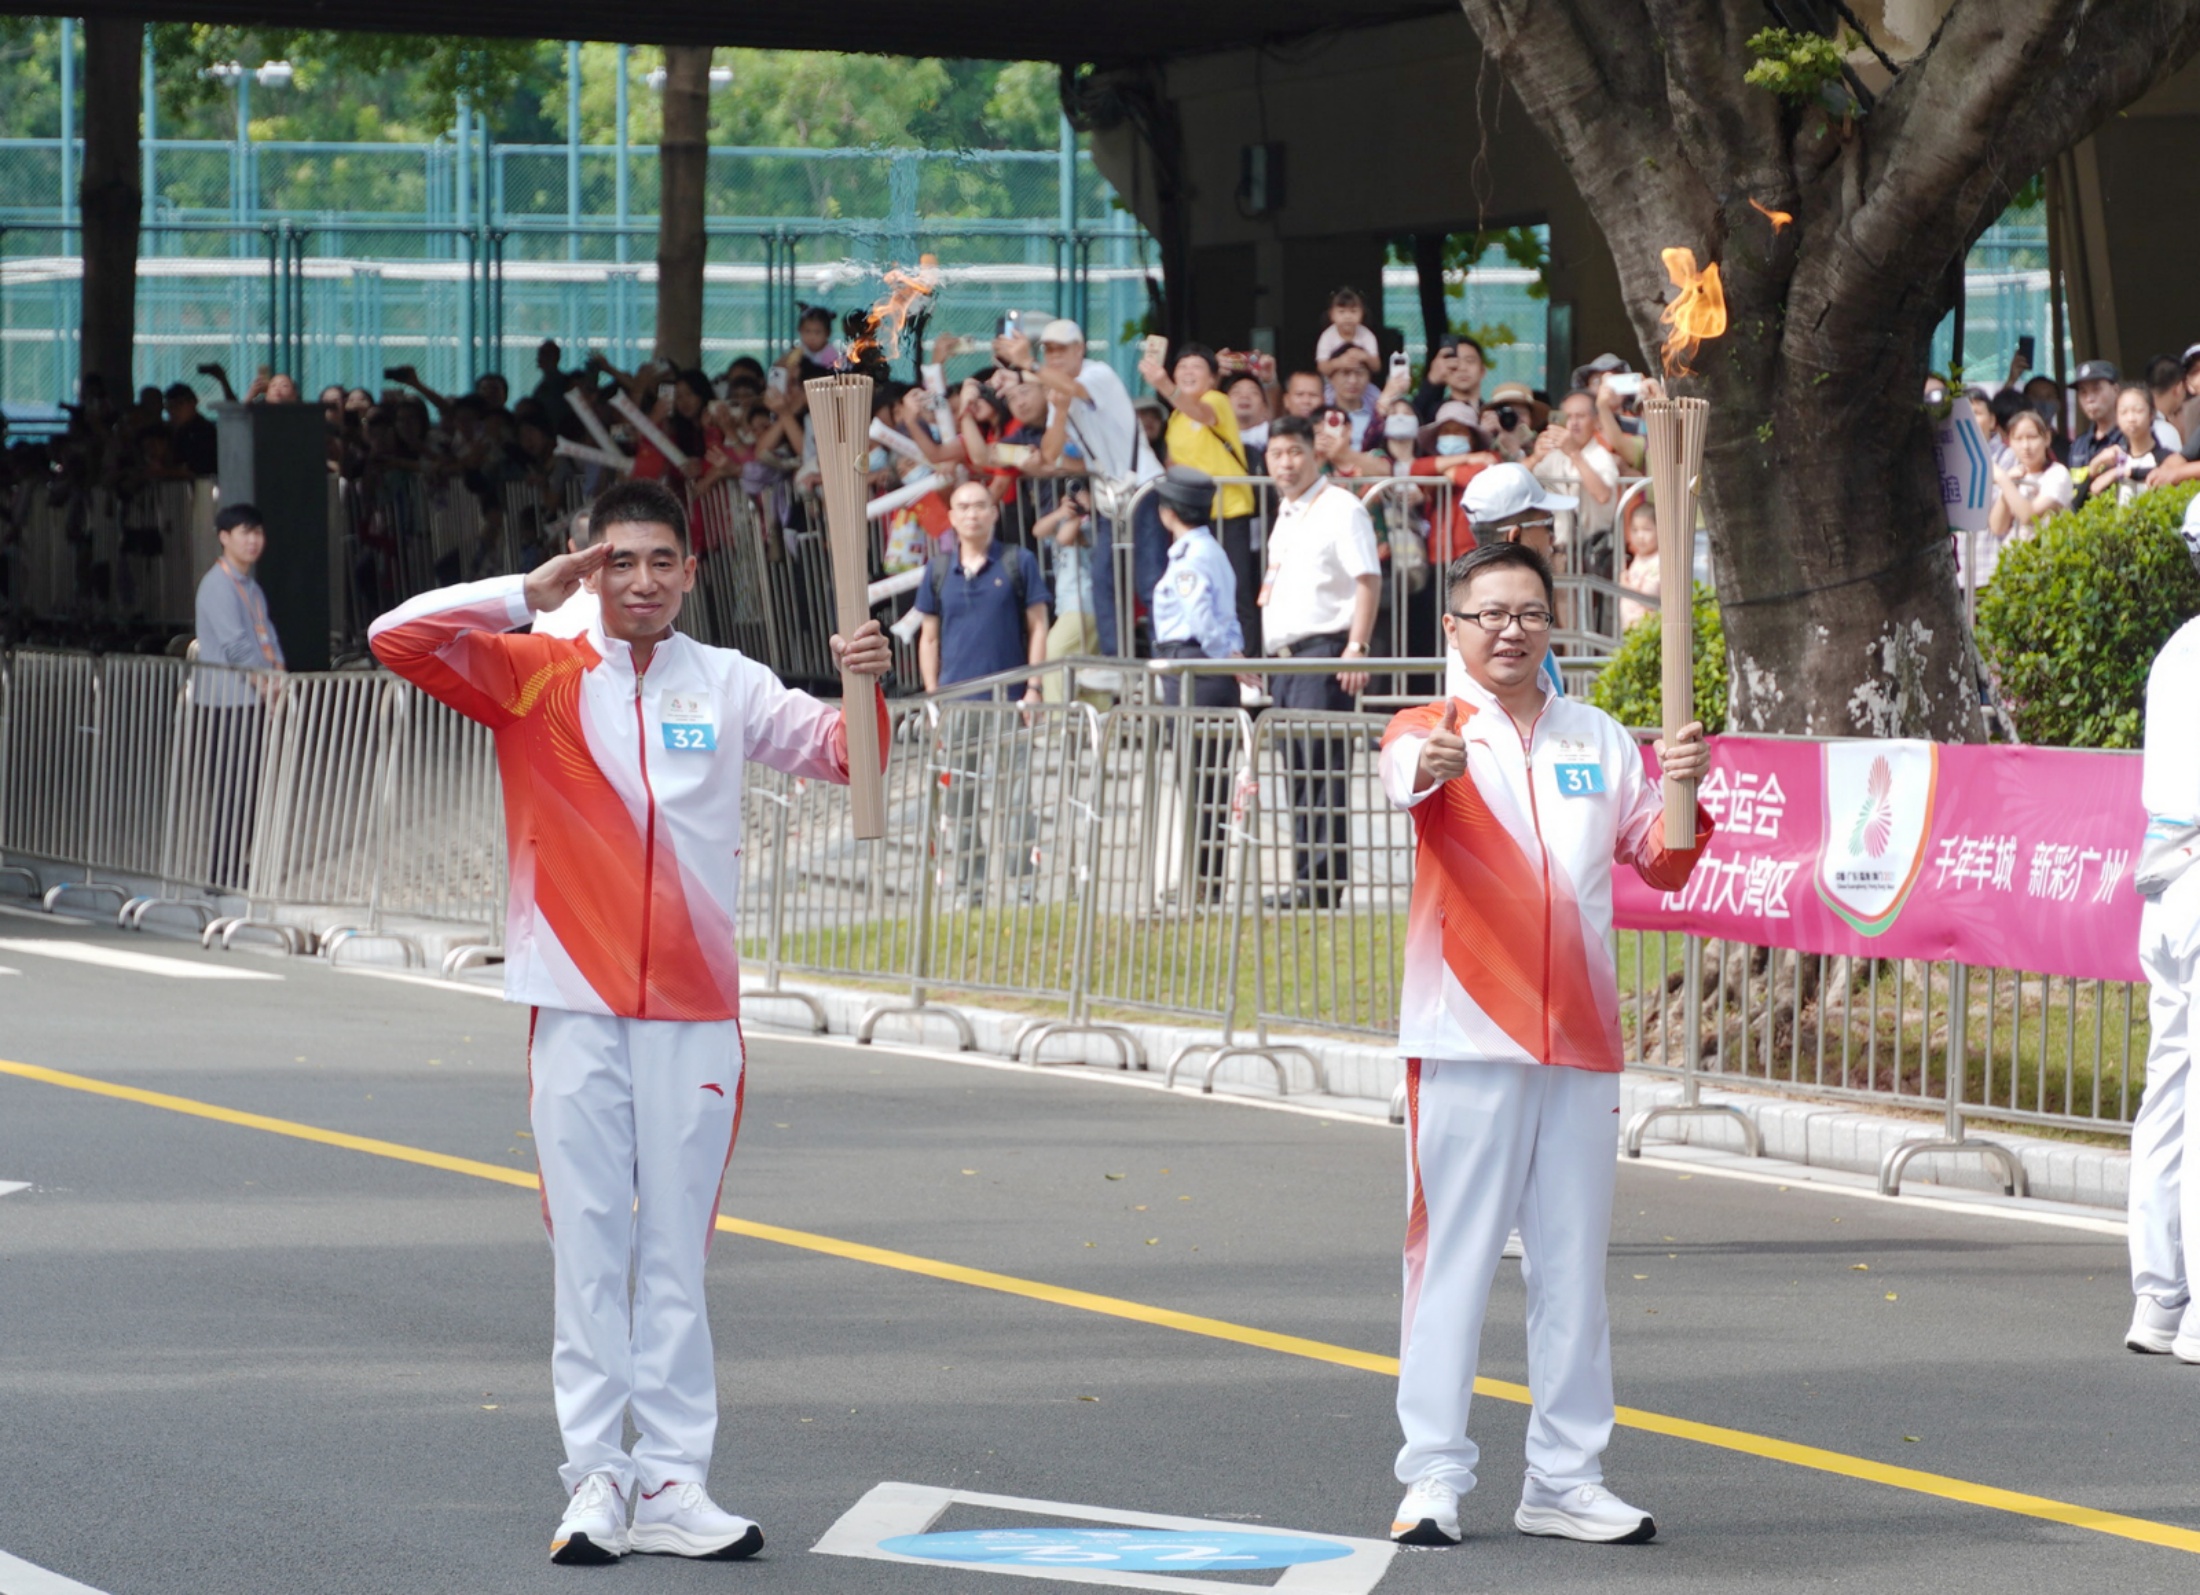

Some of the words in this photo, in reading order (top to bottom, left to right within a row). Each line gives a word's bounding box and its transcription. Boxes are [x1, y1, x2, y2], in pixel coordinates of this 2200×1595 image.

[672, 728, 706, 749] 32
[1565, 769, 1594, 791] 31
[1648, 766, 1787, 840] 全运会
[1935, 834, 2017, 892] 千年羊城
[2027, 841, 2129, 905] 新彩广州
[984, 1544, 1260, 1563] 32
